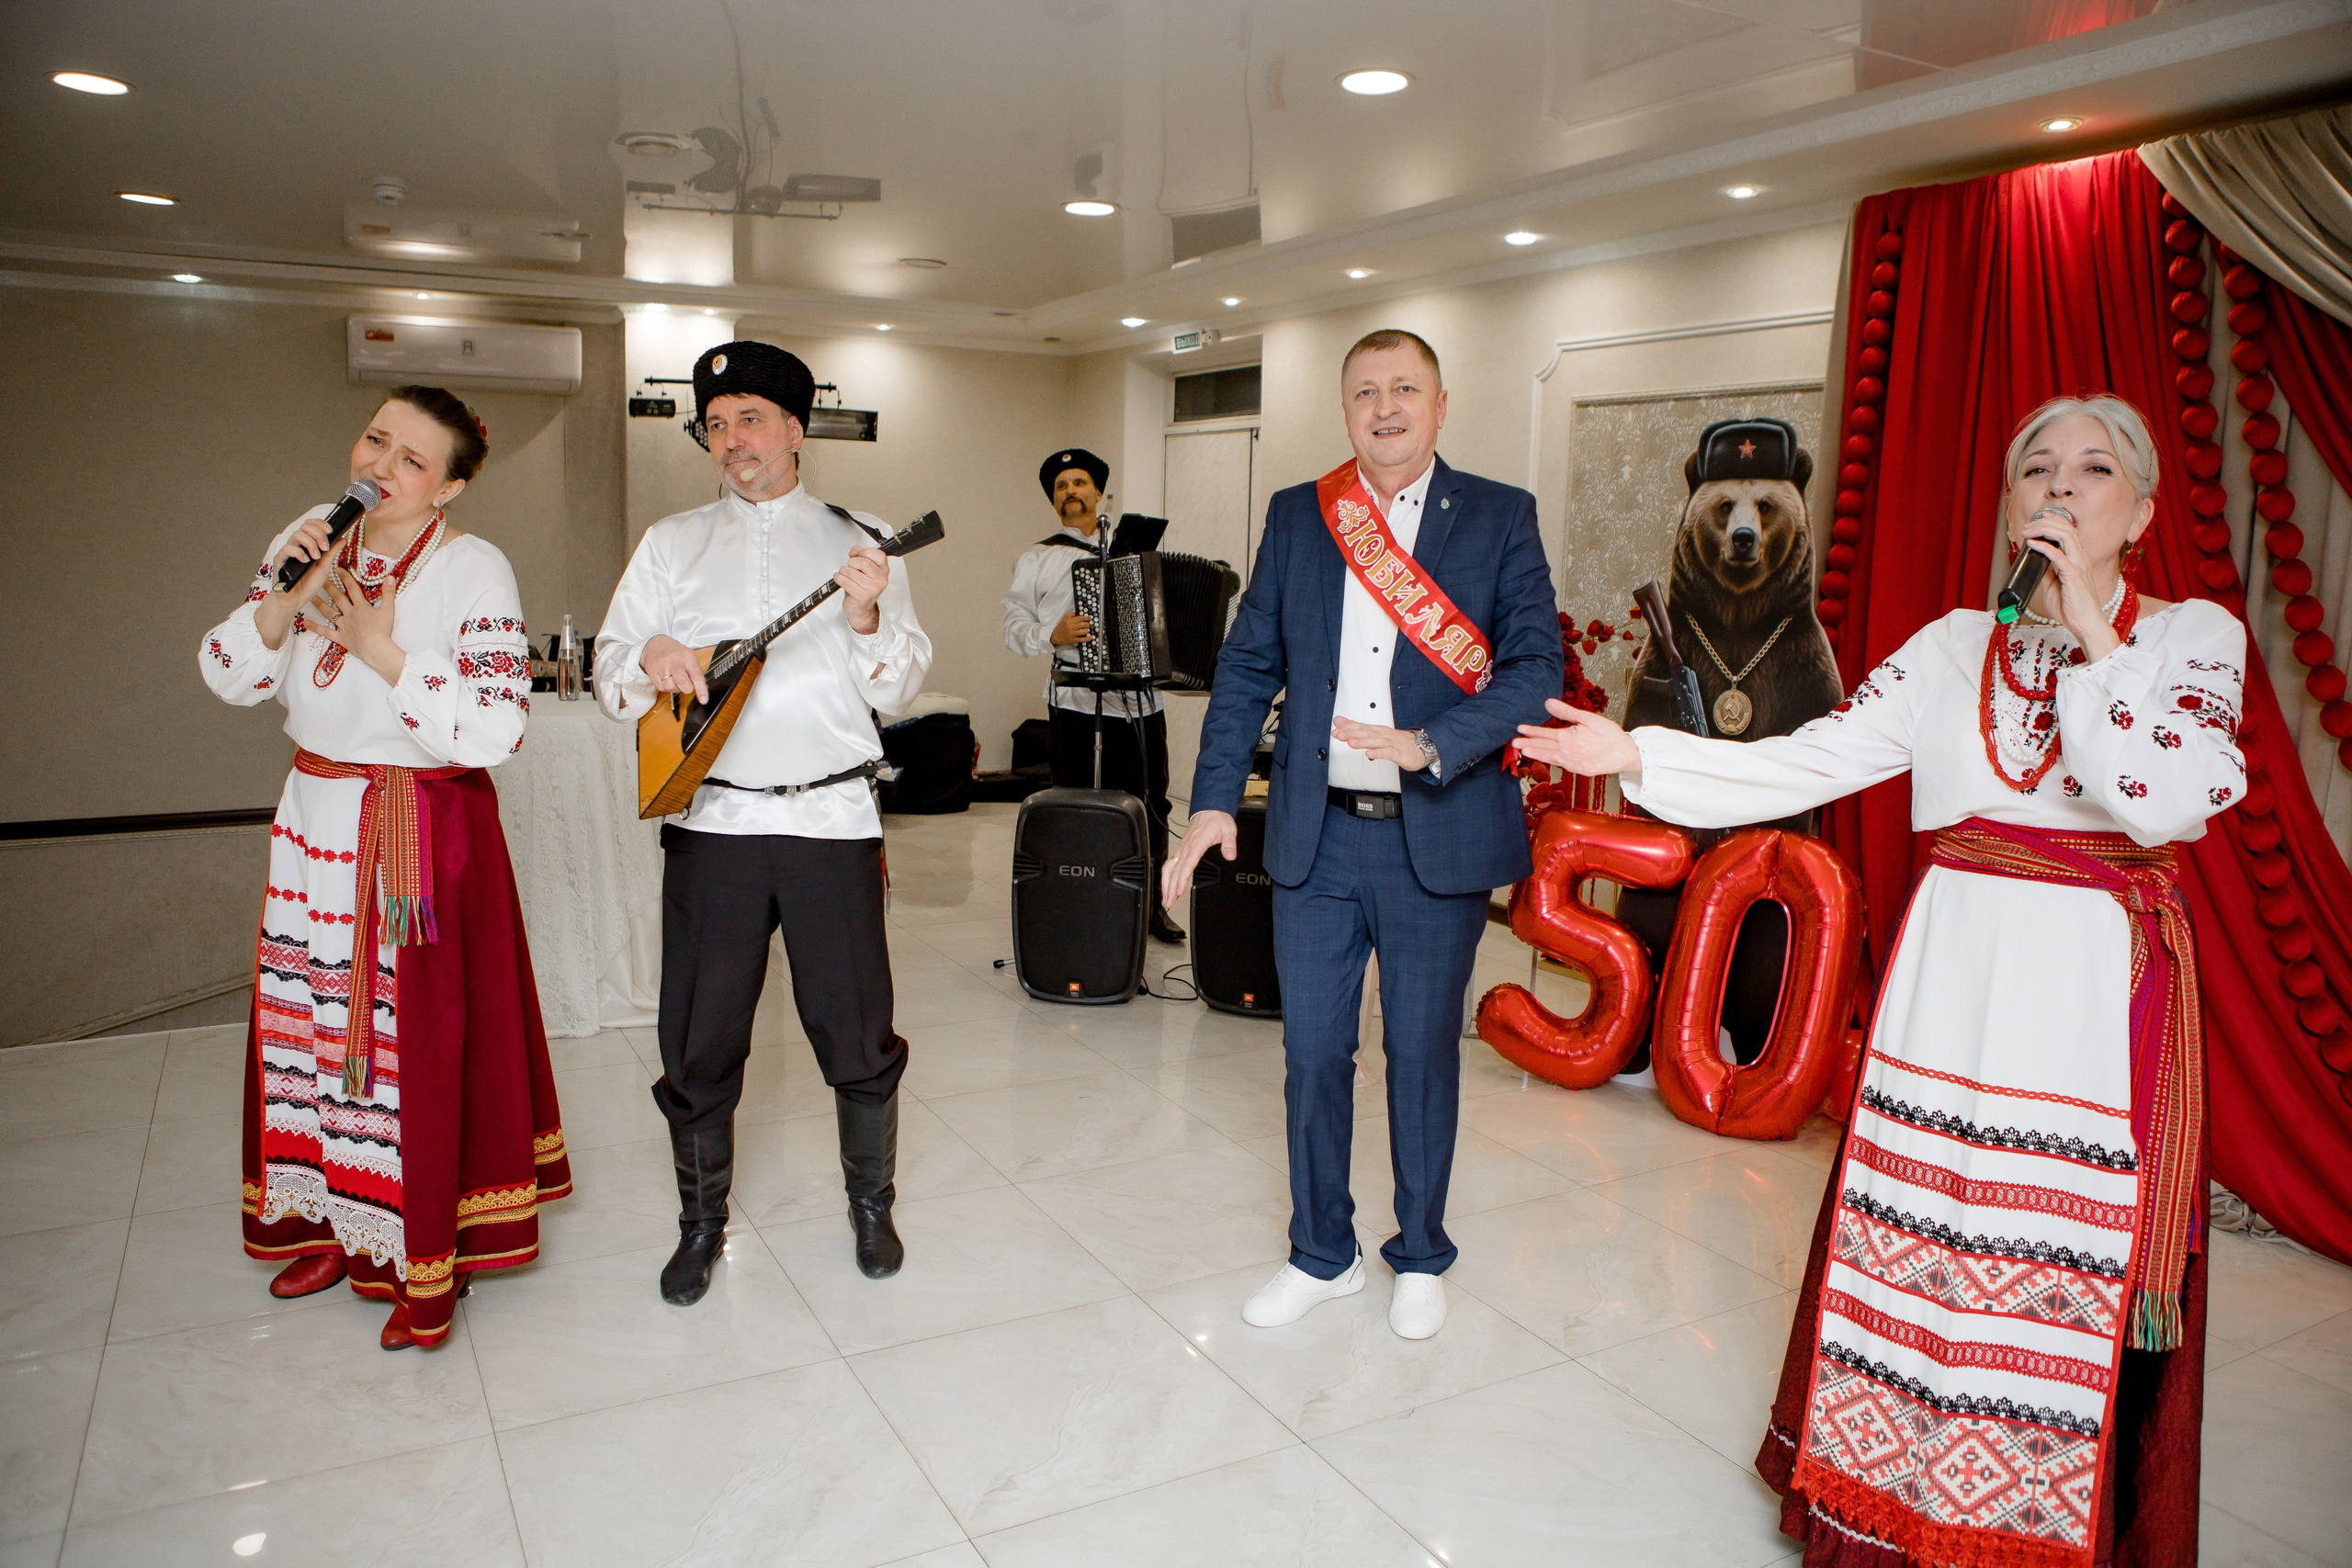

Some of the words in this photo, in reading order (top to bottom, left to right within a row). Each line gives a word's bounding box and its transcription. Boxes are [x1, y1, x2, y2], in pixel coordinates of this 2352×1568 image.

[1176, 334, 1200, 348] ВЫХОД
[1344, 519, 1487, 676] ЮБИЛЯР
[1058, 864, 1095, 877] EON
[1235, 873, 1272, 886] EON
[1476, 808, 1867, 1140] 50
